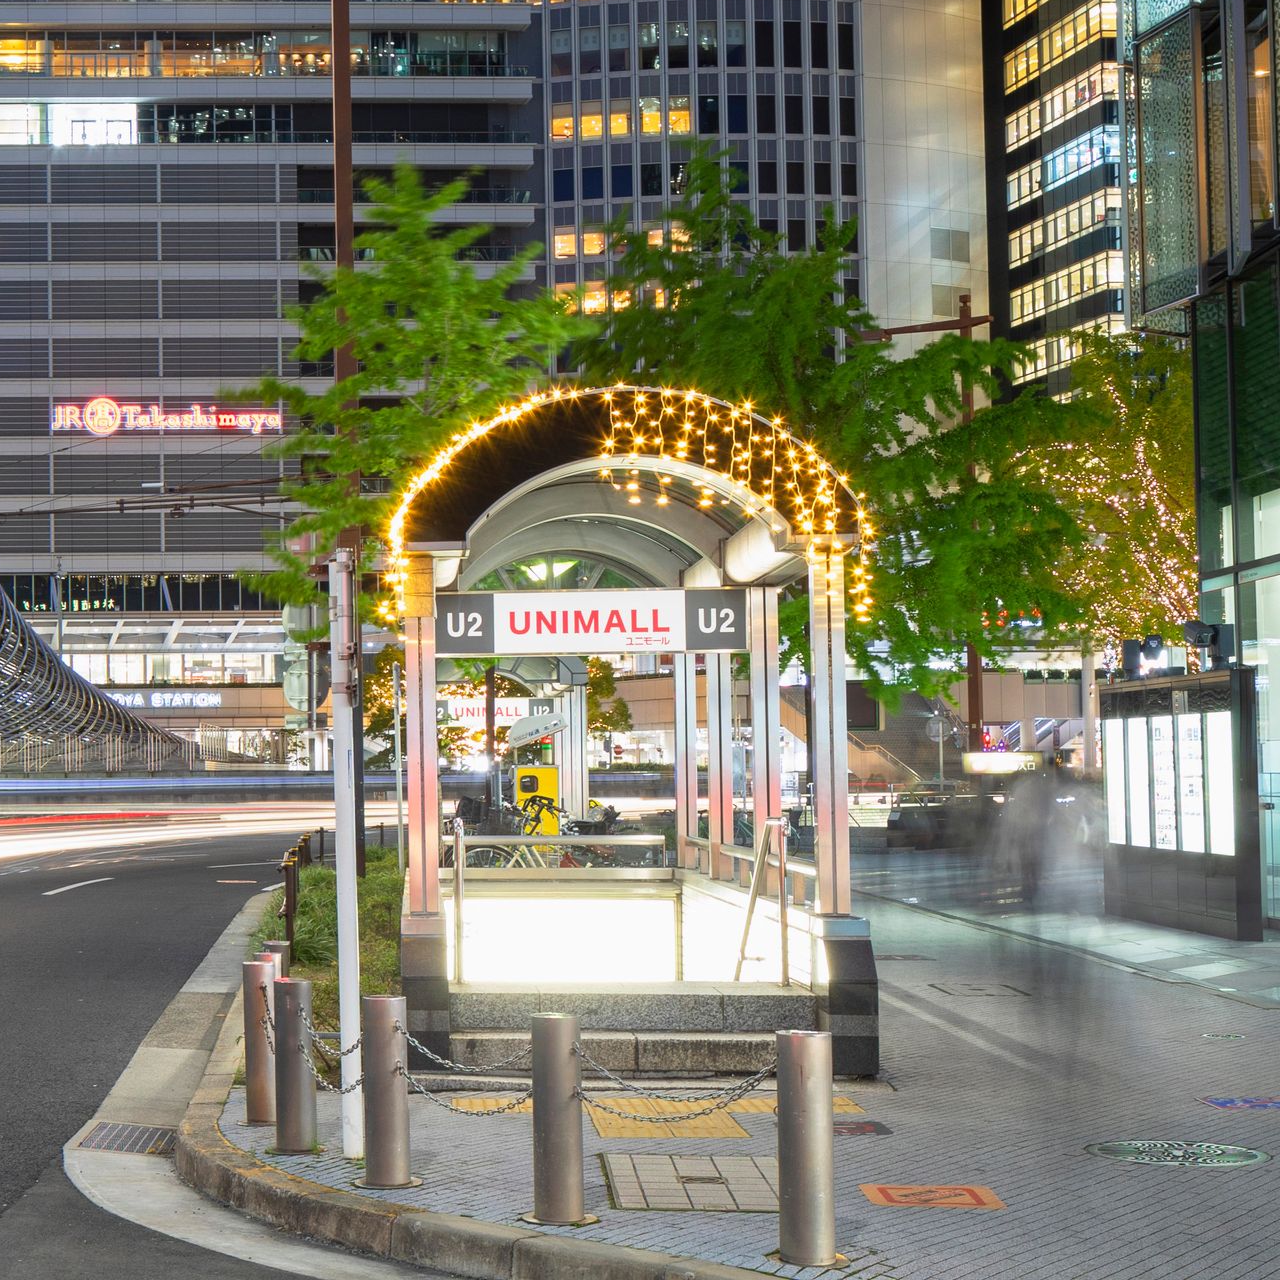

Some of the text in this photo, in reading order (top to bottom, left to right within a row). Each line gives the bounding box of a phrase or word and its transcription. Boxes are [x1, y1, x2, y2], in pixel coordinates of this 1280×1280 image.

[53, 404, 82, 429] JR
[121, 404, 281, 434] Takashimaya
[446, 608, 735, 638] U2 UNIMALL U2
[626, 637, 670, 646] ユニモール
[151, 692, 221, 707] STATION
